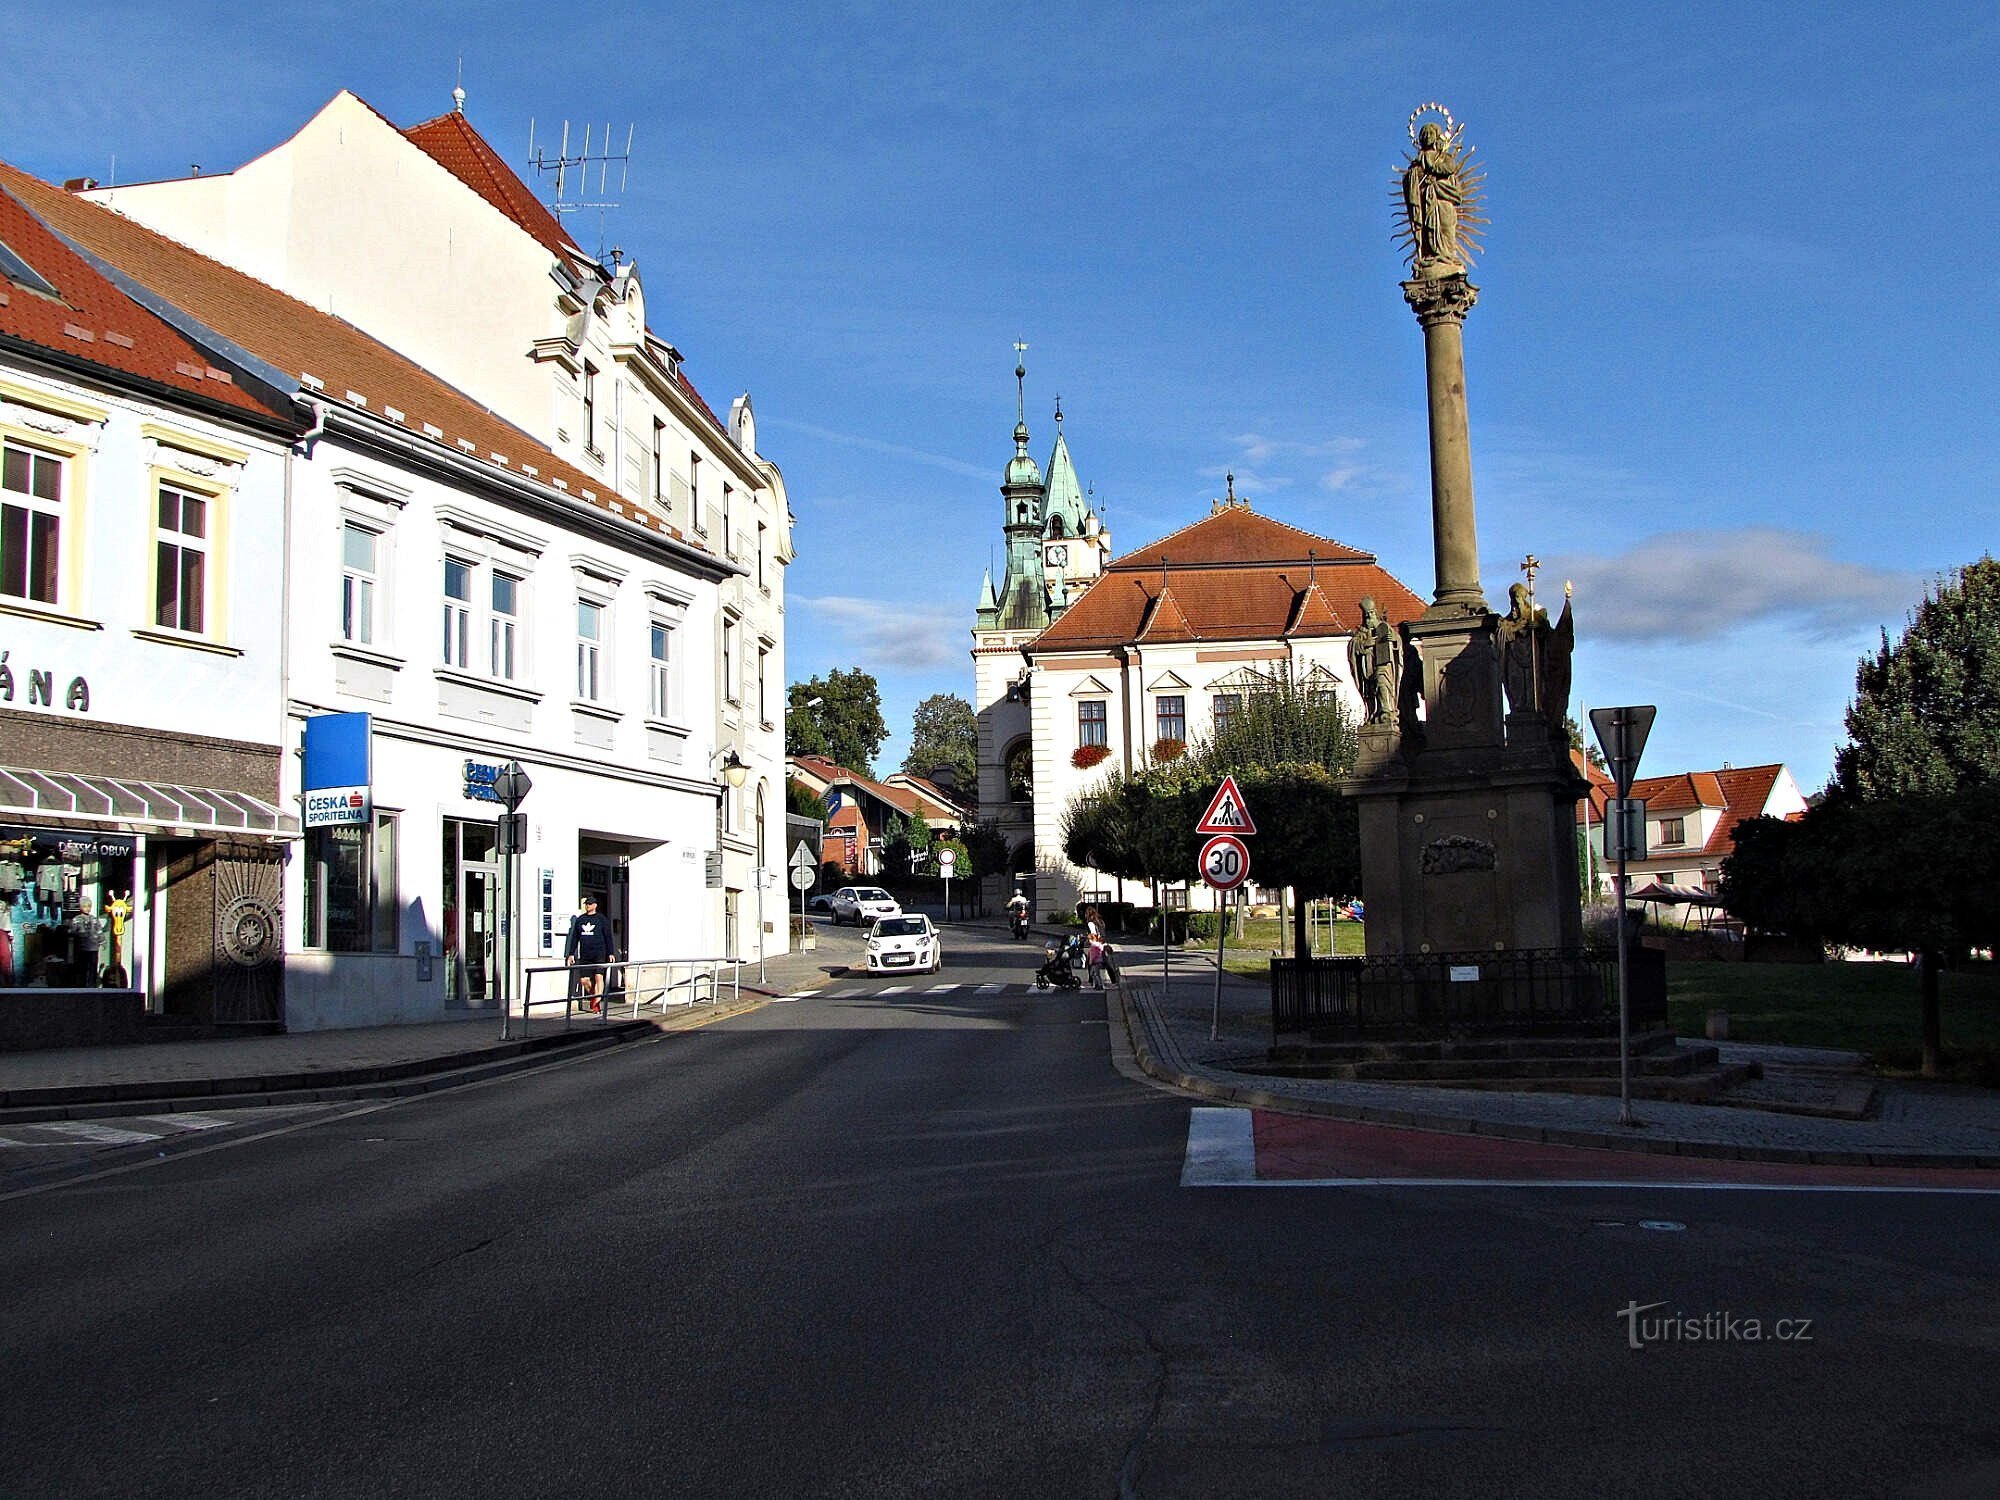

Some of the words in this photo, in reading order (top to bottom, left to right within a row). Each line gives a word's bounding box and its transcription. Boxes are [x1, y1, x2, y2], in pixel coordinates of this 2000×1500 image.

[308, 795, 348, 810] ČESKÁ
[308, 810, 363, 822] SPOŘITELNA
[101, 845, 129, 857] OBUV
[1209, 850, 1239, 876] 30
